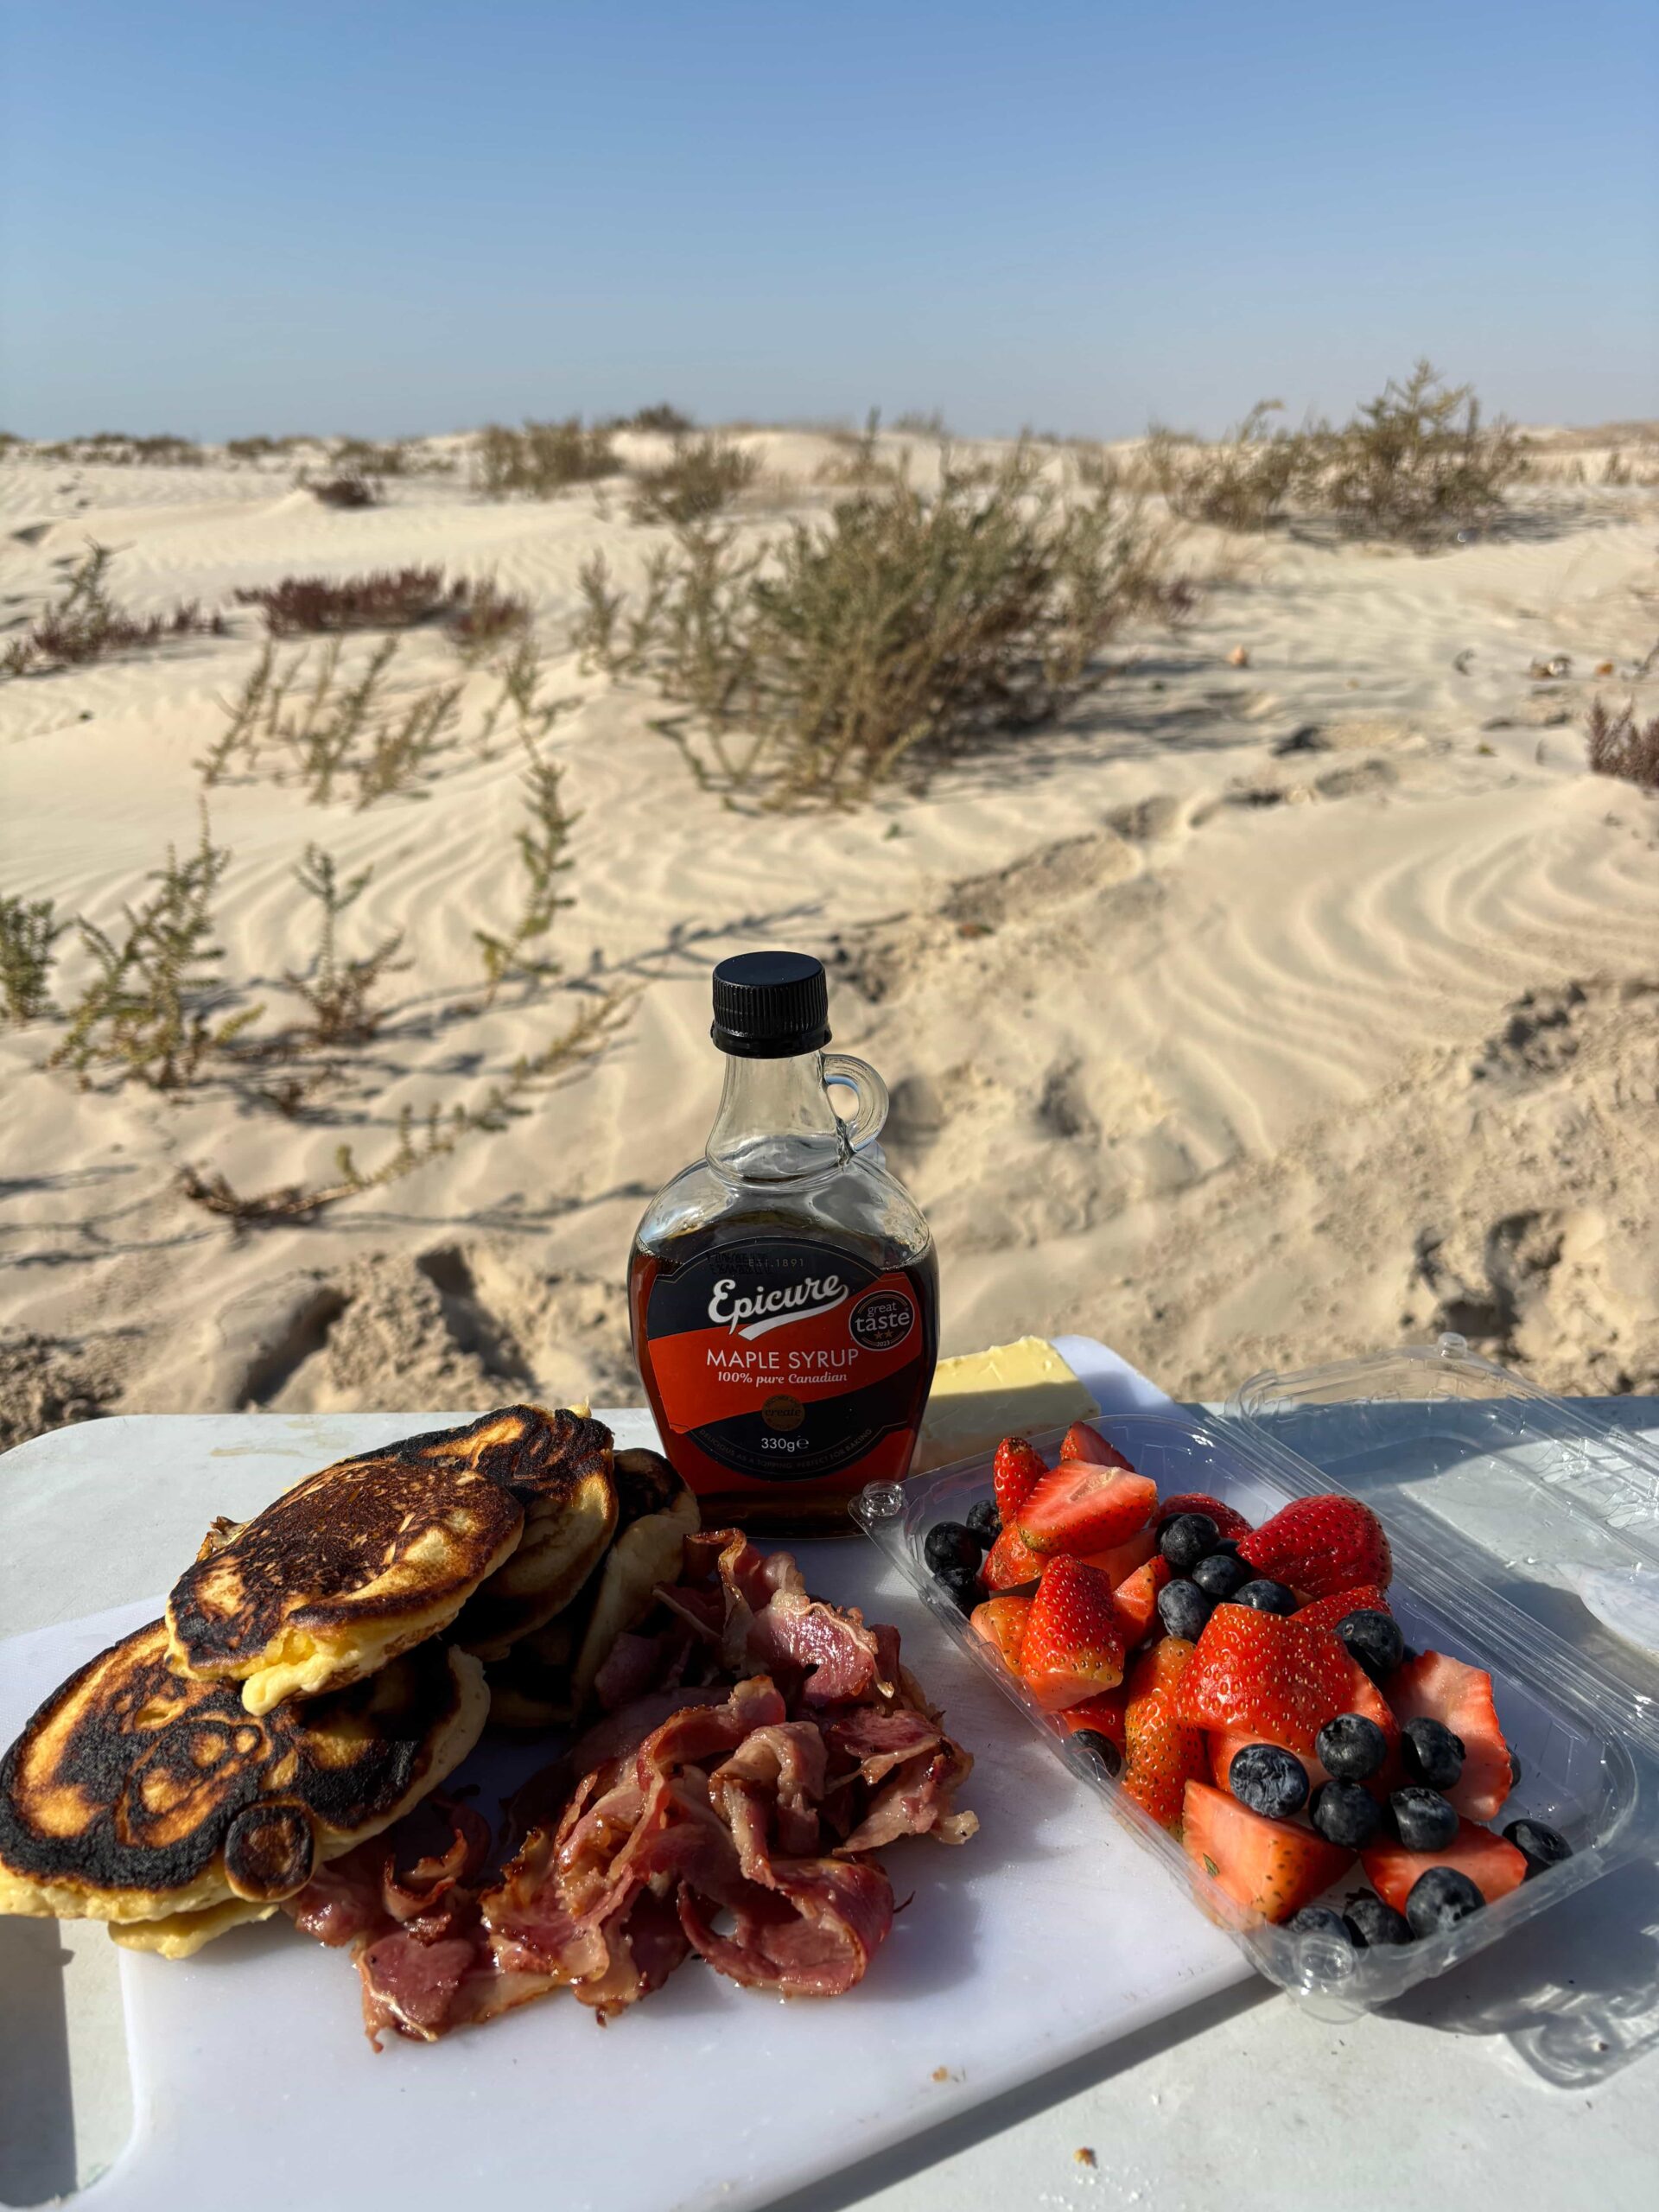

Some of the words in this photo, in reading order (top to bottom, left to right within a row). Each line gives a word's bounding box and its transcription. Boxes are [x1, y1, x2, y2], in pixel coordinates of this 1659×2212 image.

[707, 1274, 849, 1341] Epicure
[867, 1301, 897, 1318] great
[855, 1312, 911, 1332] taste
[706, 1348, 780, 1369] MAPLE
[787, 1348, 859, 1369] SYRUP
[717, 1370, 753, 1383] 100%
[755, 1373, 785, 1387] pure
[788, 1371, 848, 1384] Canadian
[844, 1428, 873, 1452] BAKING
